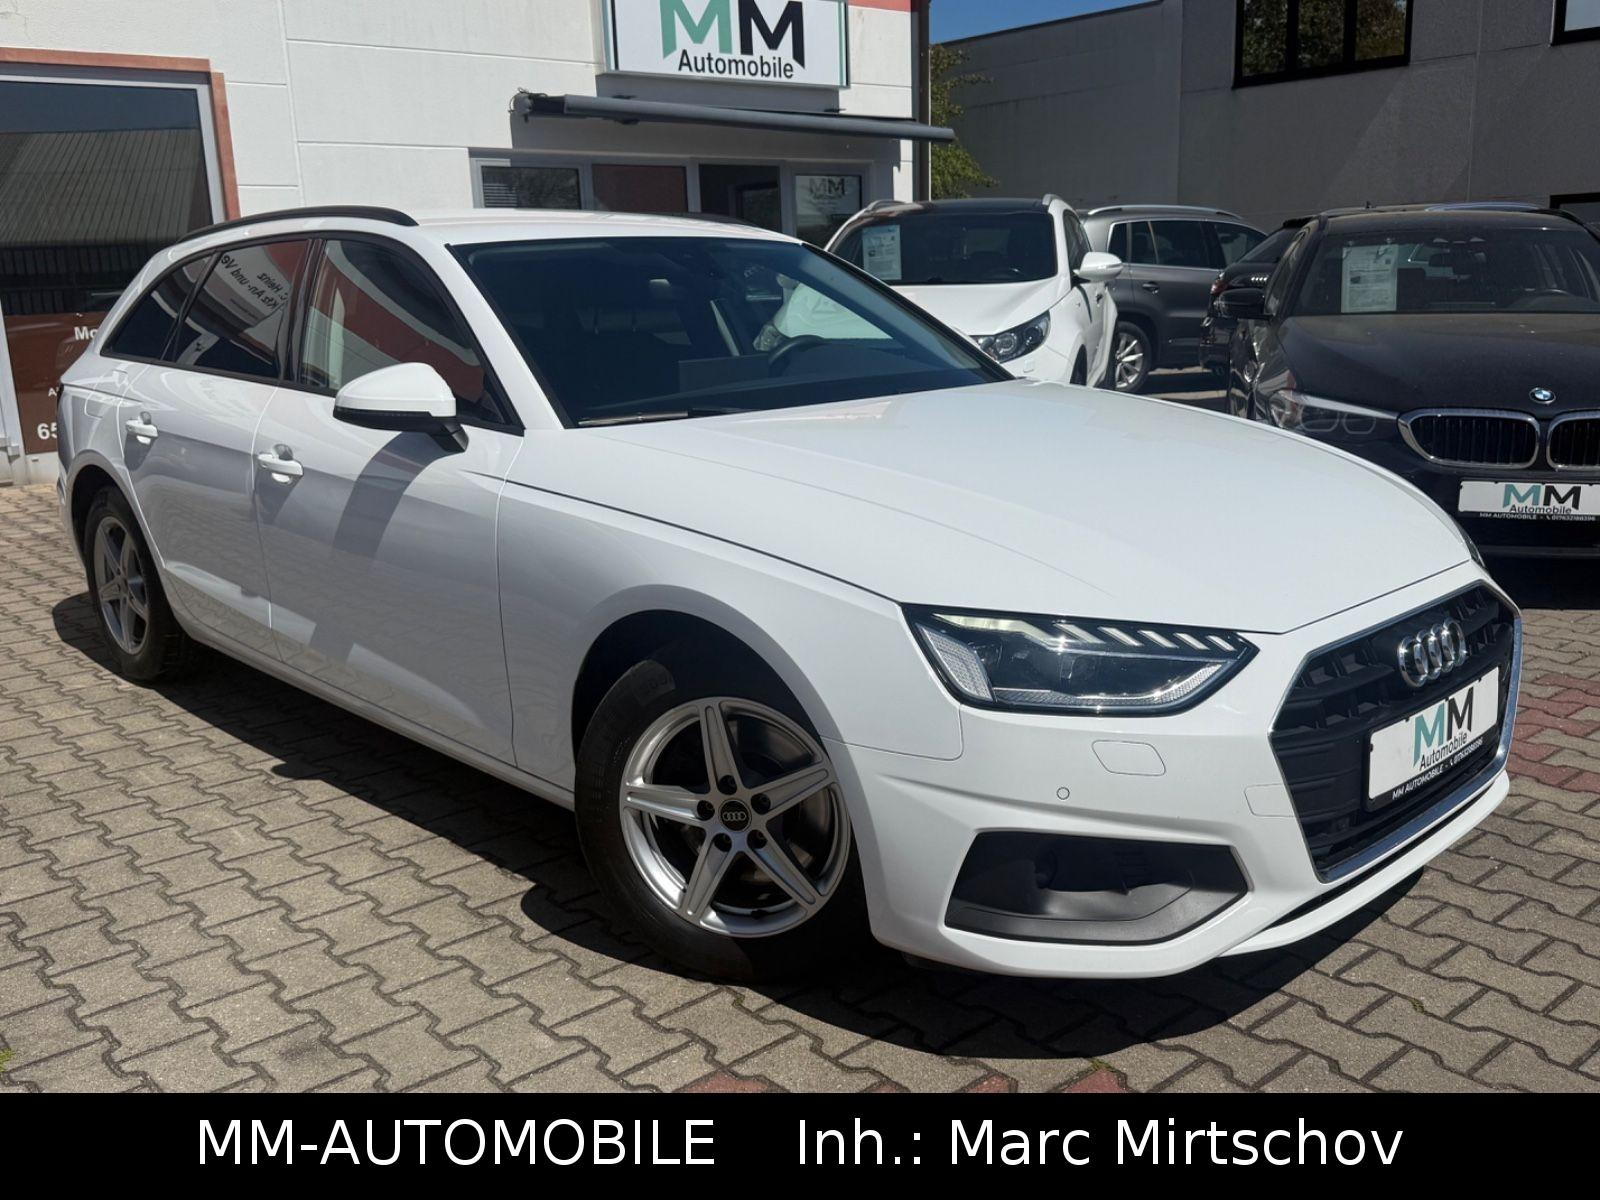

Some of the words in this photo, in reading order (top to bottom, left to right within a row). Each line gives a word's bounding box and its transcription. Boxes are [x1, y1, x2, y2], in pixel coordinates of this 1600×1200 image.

[659, 0, 805, 69] MM
[678, 49, 794, 79] Automobile
[809, 177, 846, 196] MM
[1502, 484, 1582, 510] MM
[1509, 504, 1571, 514] Automobile
[1493, 512, 1537, 520] AUTOMOBILE
[1413, 686, 1474, 768] MM
[1419, 732, 1468, 773] Automobile
[1392, 787, 1406, 800] MM
[1404, 763, 1444, 794] AUTOMOBILE
